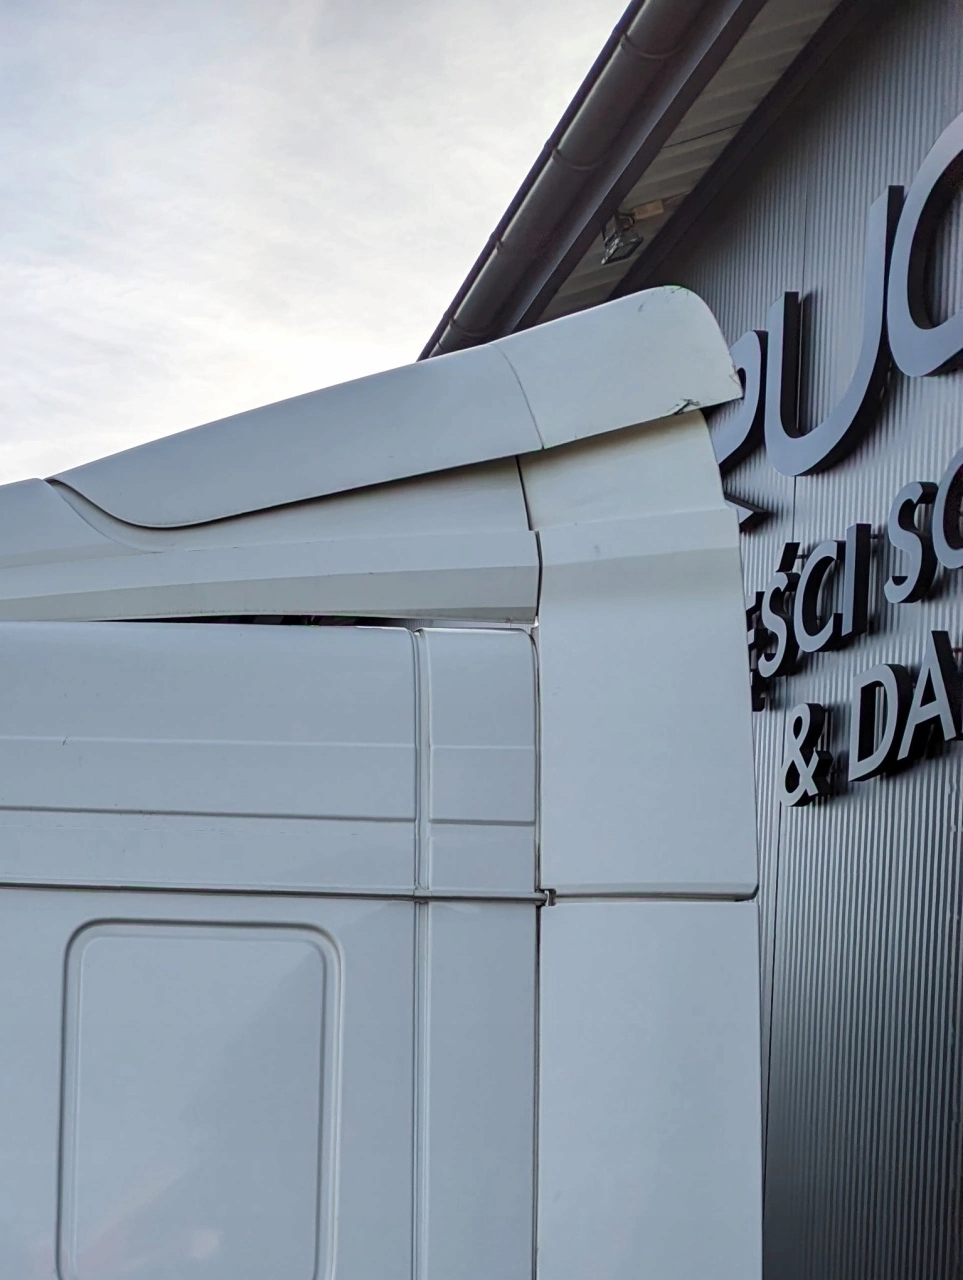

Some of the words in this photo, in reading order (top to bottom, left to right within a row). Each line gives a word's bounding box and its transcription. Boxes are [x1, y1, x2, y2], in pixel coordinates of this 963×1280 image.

[745, 523, 872, 713] ŚCI
[780, 703, 826, 808] &
[848, 630, 963, 782] DA
